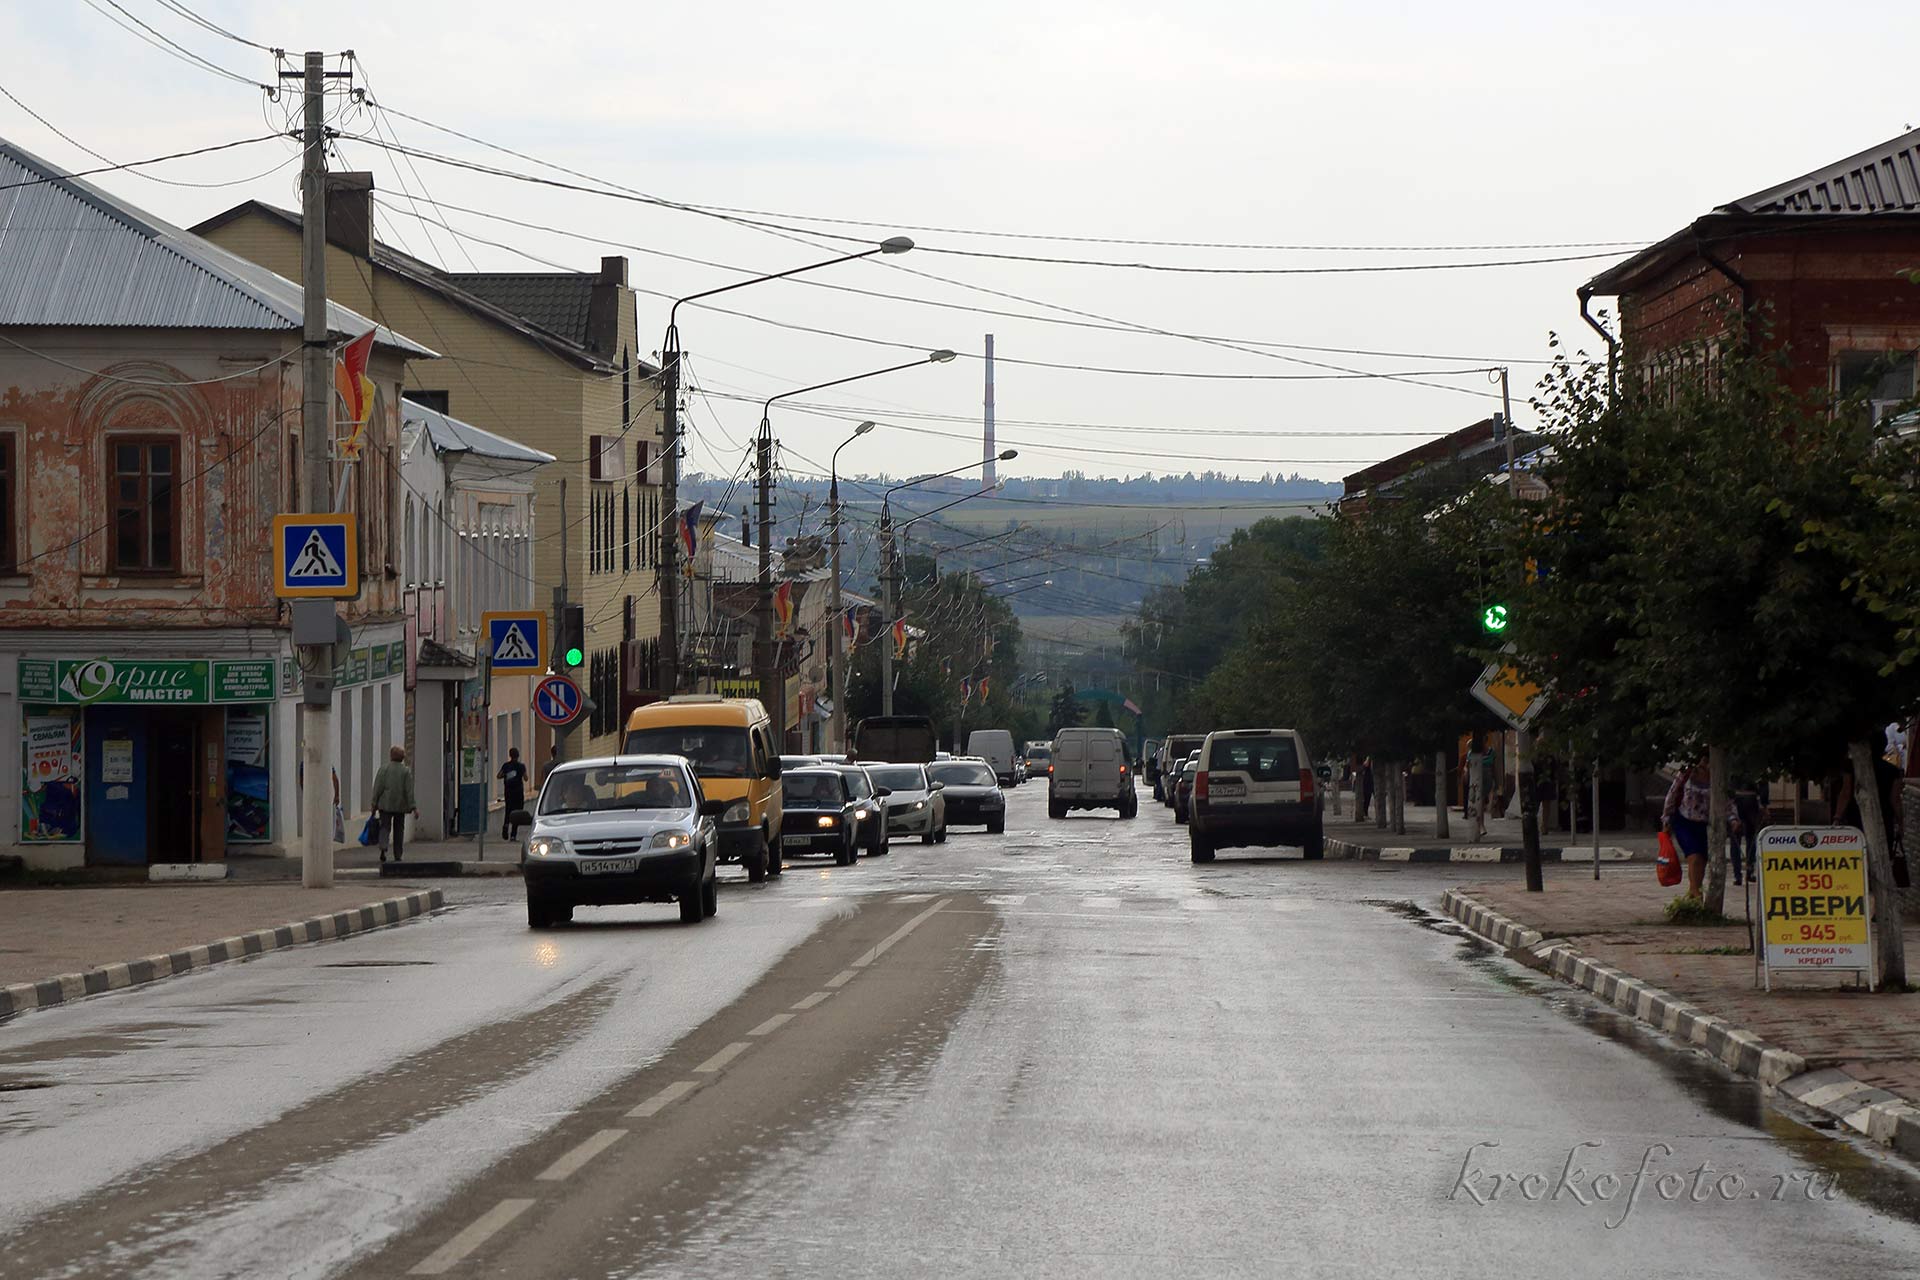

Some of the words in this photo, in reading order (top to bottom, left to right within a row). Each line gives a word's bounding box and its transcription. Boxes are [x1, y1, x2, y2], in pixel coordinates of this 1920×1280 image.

[76, 660, 188, 701] Офис
[130, 688, 193, 700] МАСТЕР
[32, 757, 69, 778] 10%
[1768, 835, 1797, 845] ОКНА
[1821, 835, 1858, 845] ДВЕРИ
[1766, 857, 1860, 871] ЛАМИНАТ
[1797, 874, 1833, 890] 350
[1767, 896, 1865, 920] ДВЕРИ
[1800, 924, 1836, 941] 945
[1784, 947, 1836, 955] РАССРОЧКА
[1838, 947, 1852, 955] 0%
[1798, 957, 1834, 965] КРЕДИТ
